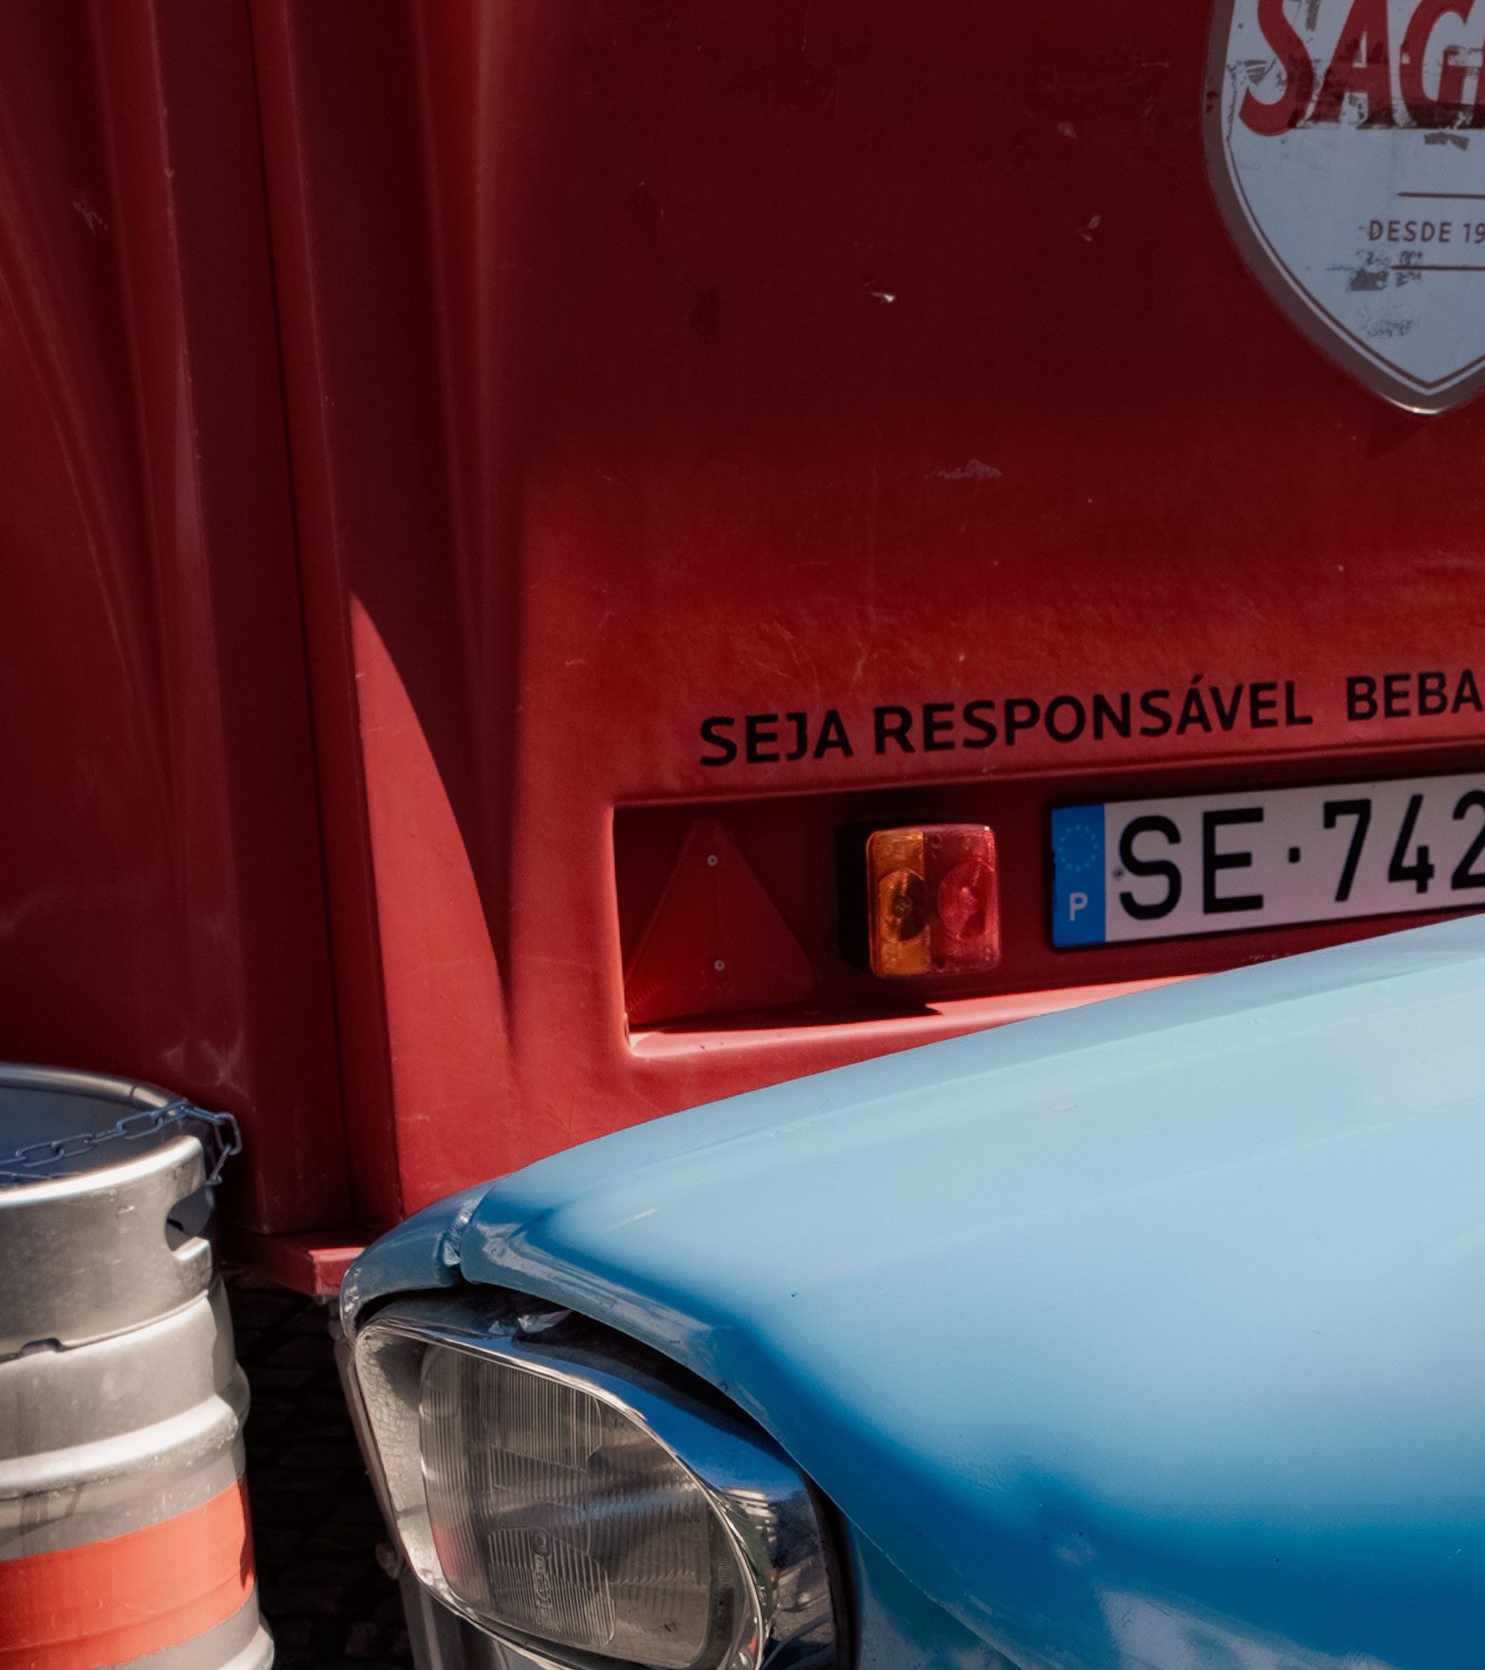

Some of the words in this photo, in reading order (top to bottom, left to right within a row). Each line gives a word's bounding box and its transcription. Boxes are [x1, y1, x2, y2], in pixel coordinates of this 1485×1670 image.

[1367, 218, 1453, 245] DESDE
[698, 709, 855, 768] SEJA
[873, 671, 1314, 753] RESPONSÁVEL
[1345, 667, 1485, 723] BEBA
[1068, 891, 1090, 922] P
